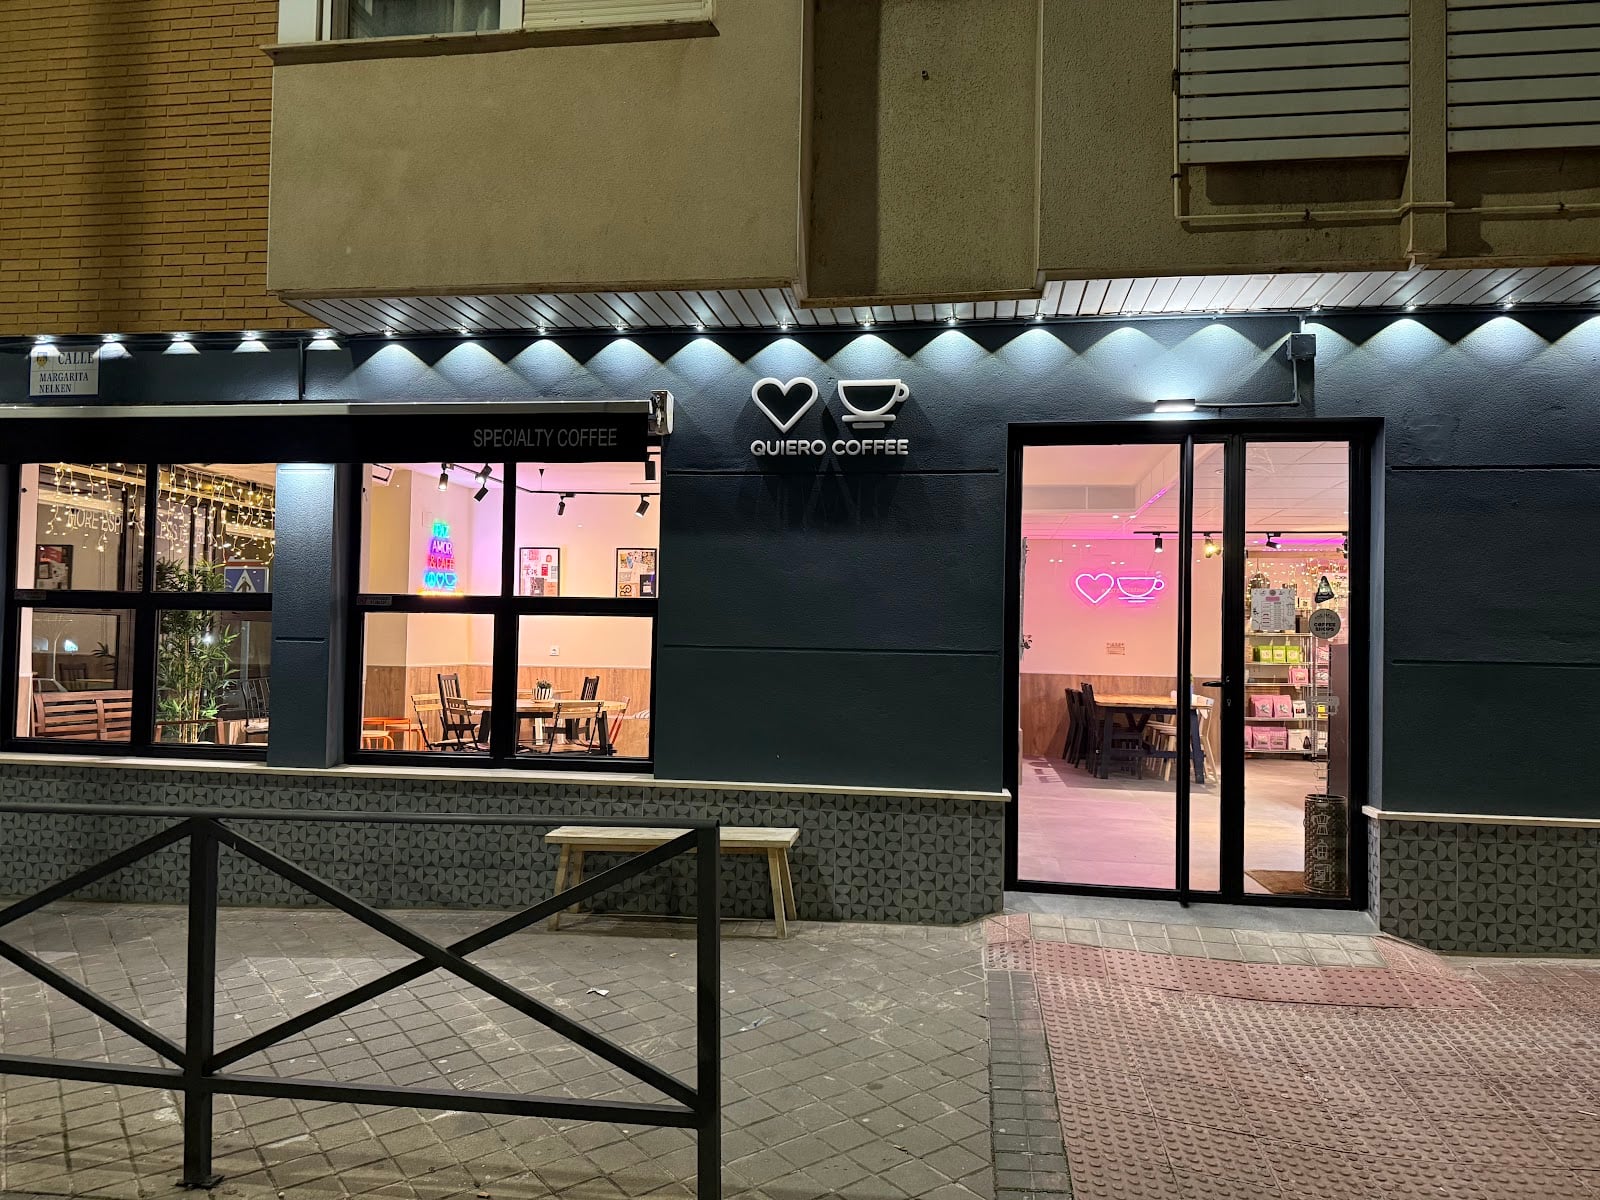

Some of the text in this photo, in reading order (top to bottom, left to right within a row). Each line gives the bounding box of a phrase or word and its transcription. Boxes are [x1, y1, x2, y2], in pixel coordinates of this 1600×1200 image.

[57, 351, 95, 365] CALLE
[39, 372, 89, 382] MARGARITA
[39, 383, 72, 393] NELKEN
[473, 428, 618, 447] SPECIALTY COFFEE
[750, 438, 909, 456] QUIERO COFFEE
